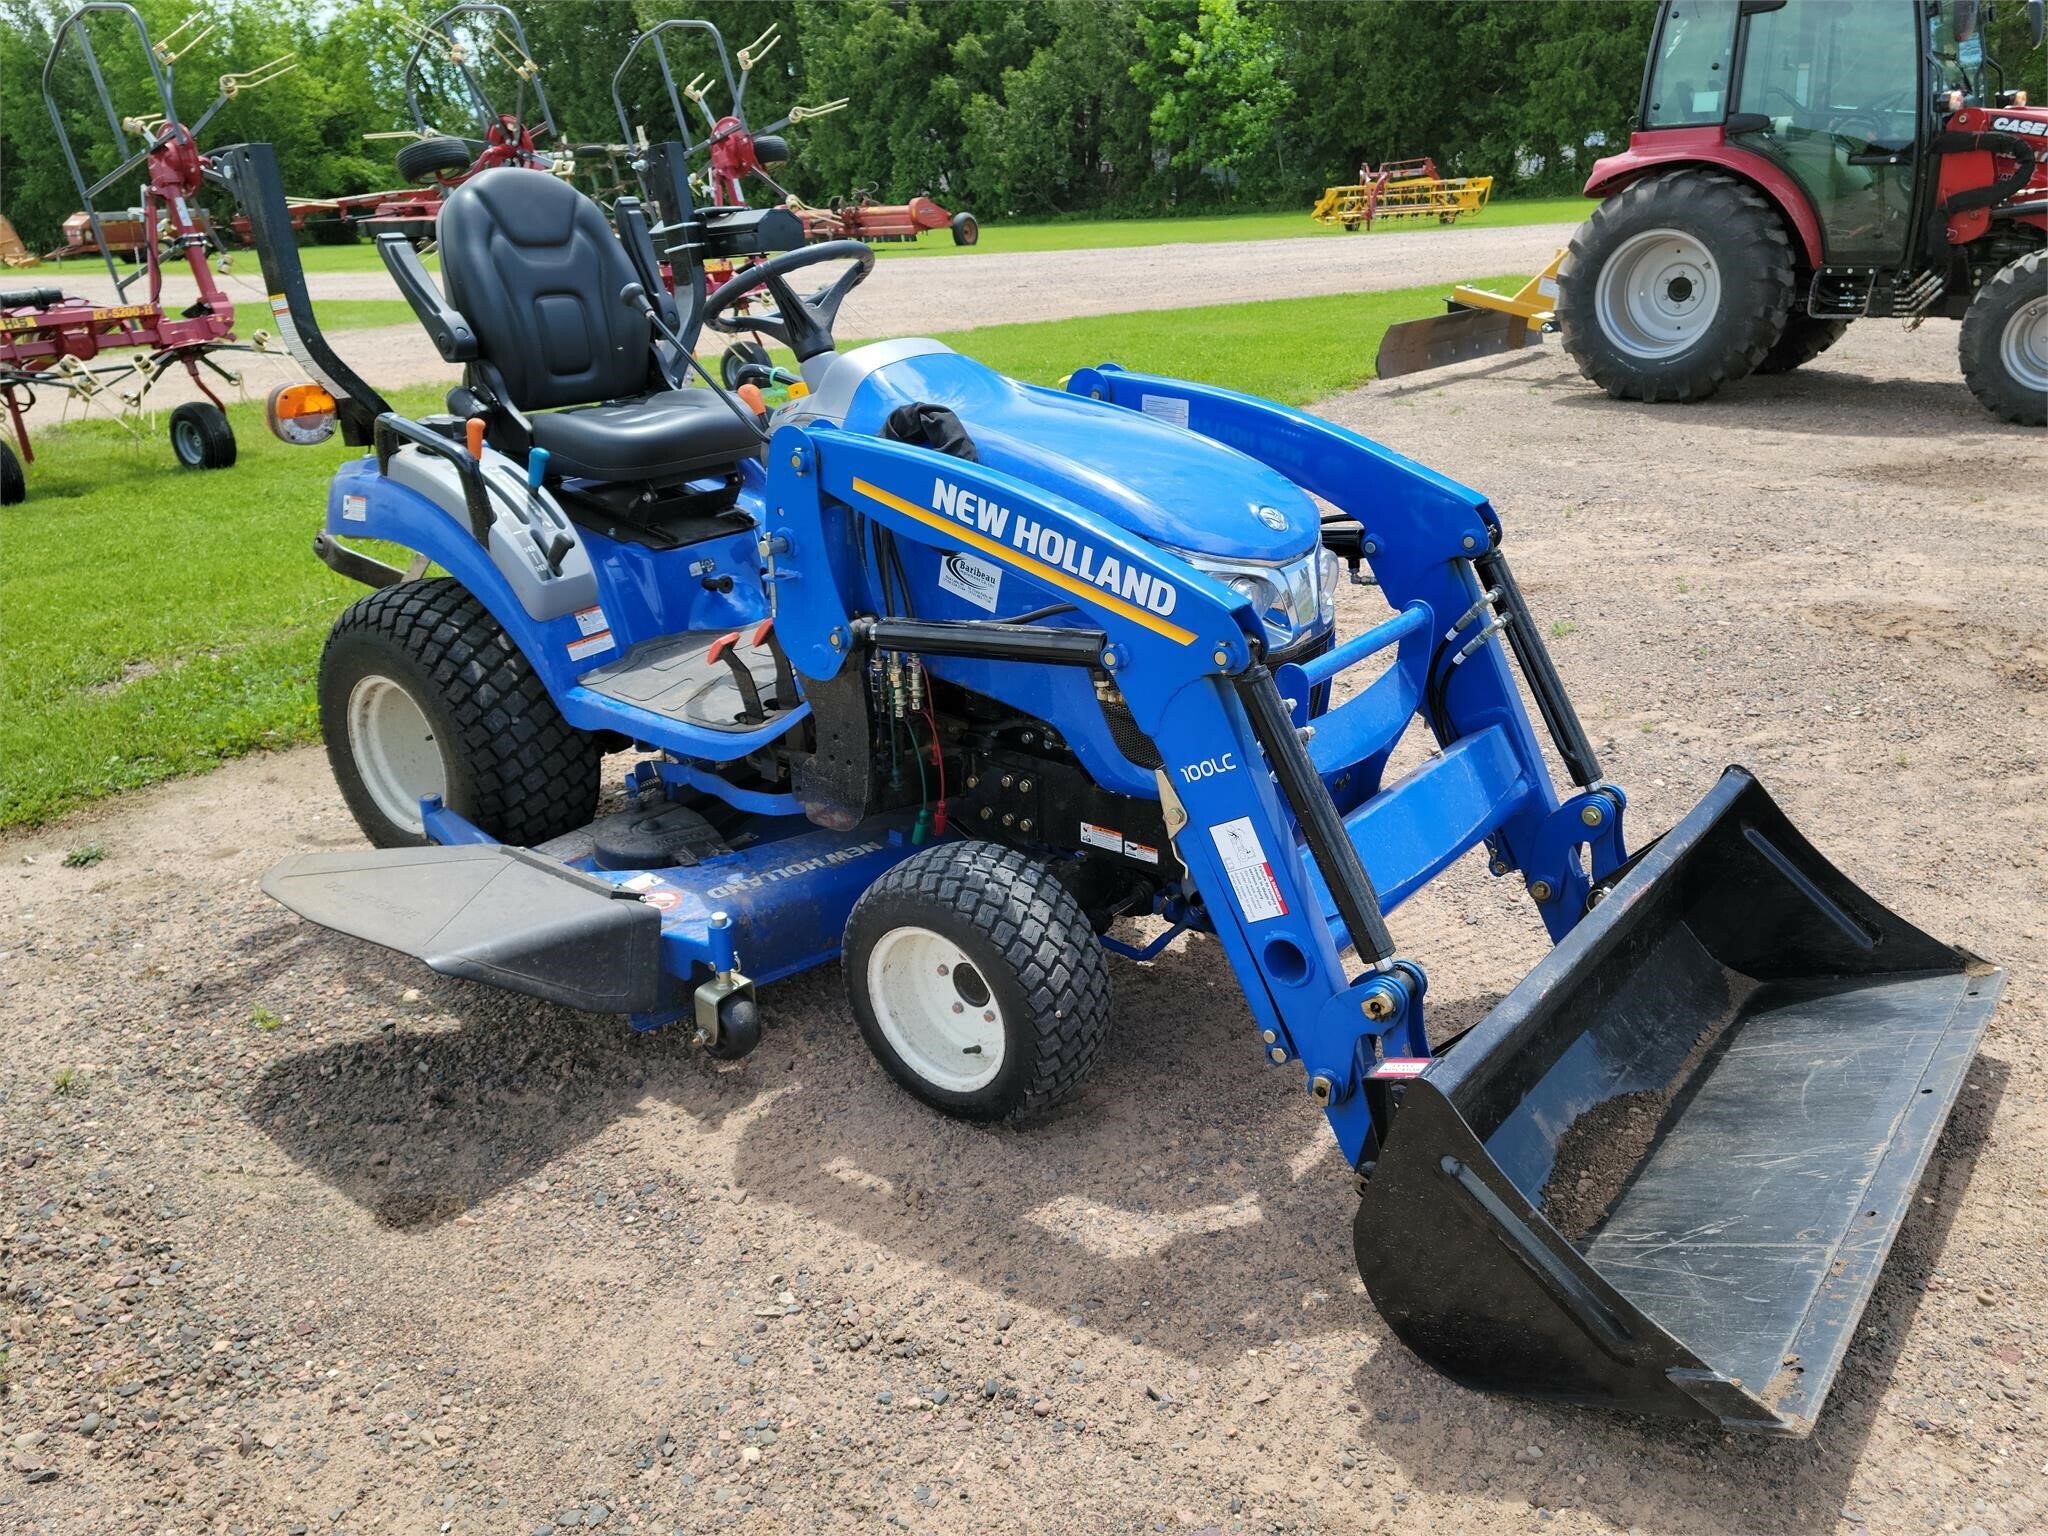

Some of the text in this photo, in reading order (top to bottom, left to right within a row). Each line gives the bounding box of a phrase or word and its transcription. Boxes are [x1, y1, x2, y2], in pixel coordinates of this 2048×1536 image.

[931, 477, 1177, 617] NEW HOLLAND
[959, 560, 996, 584] Baribeau
[1180, 752, 1237, 783] 100LC
[706, 841, 883, 899] NEW HOLLAND
